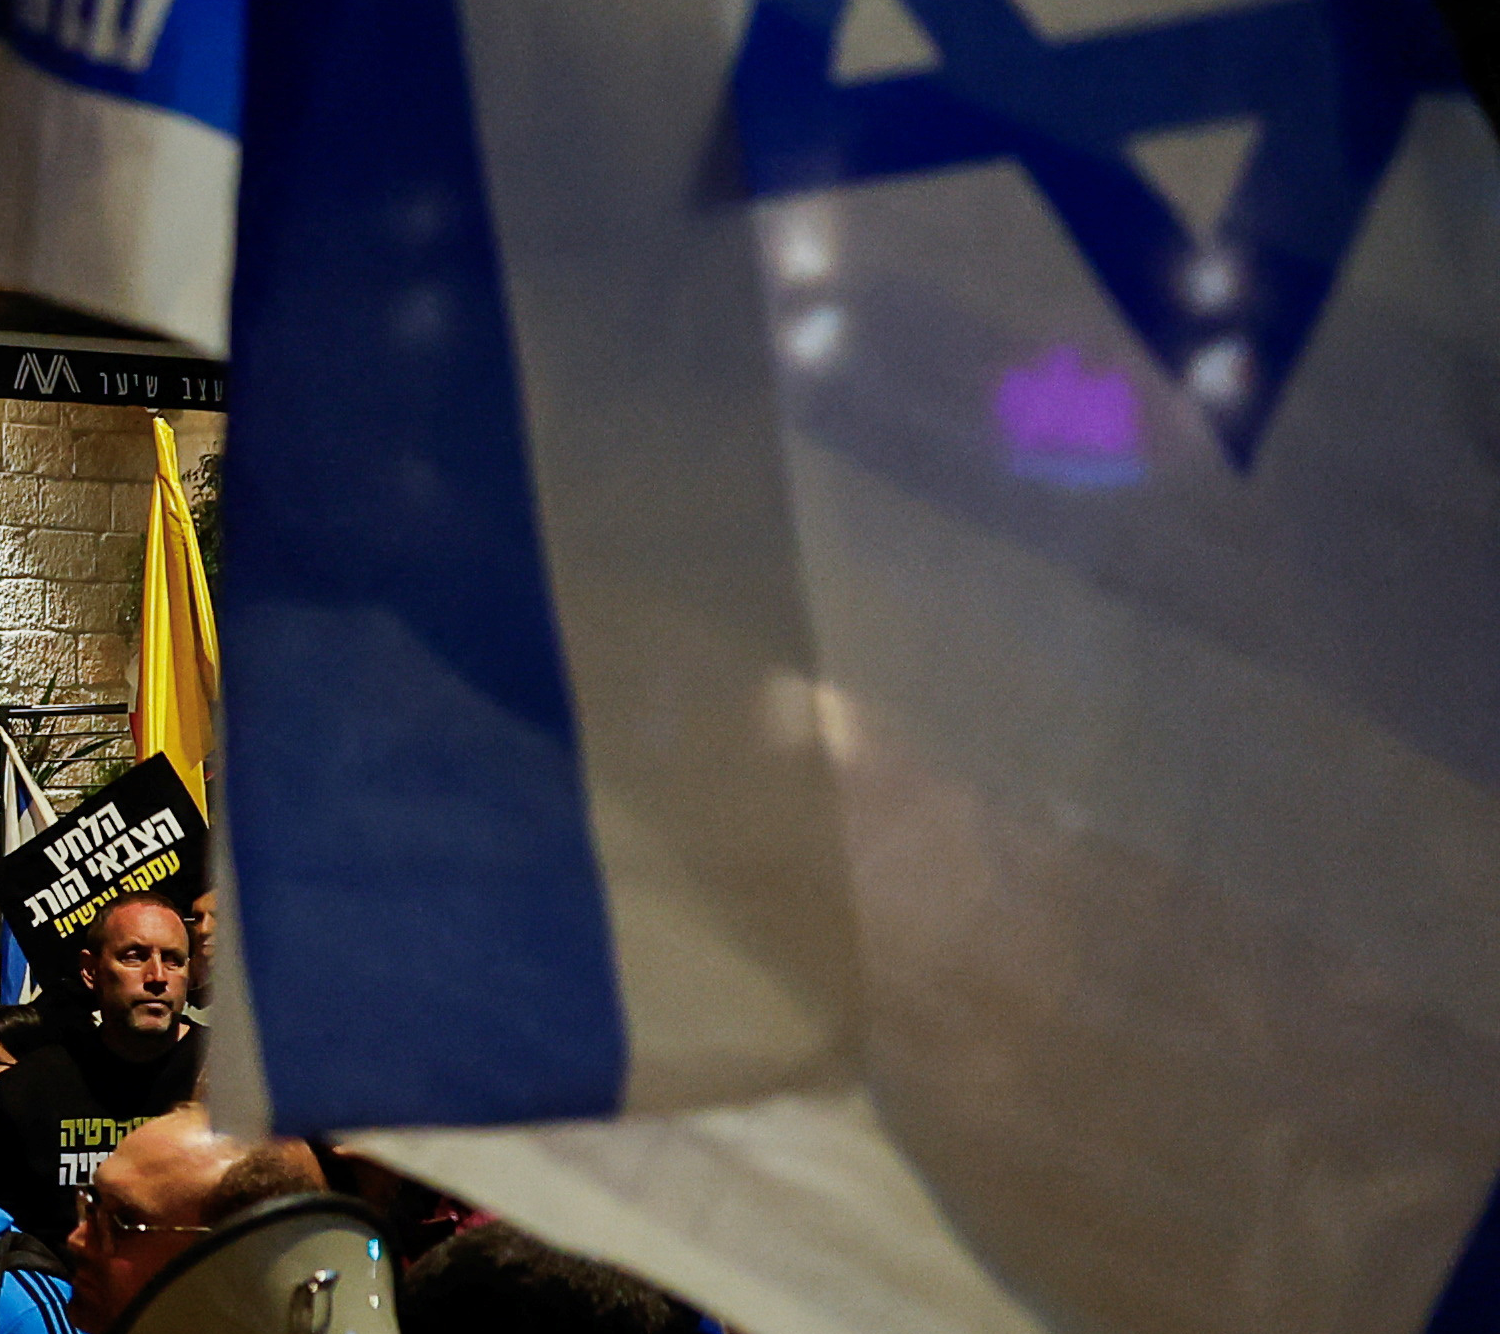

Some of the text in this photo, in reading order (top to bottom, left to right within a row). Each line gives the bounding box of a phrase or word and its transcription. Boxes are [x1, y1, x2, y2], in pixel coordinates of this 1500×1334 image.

[99, 372, 224, 402] עצב שיער
[43, 800, 127, 875] הלחץ
[23, 806, 186, 928] הצבאי הורג
[118, 849, 181, 893] עסקה
[60, 1116, 154, 1148] קרטיה
